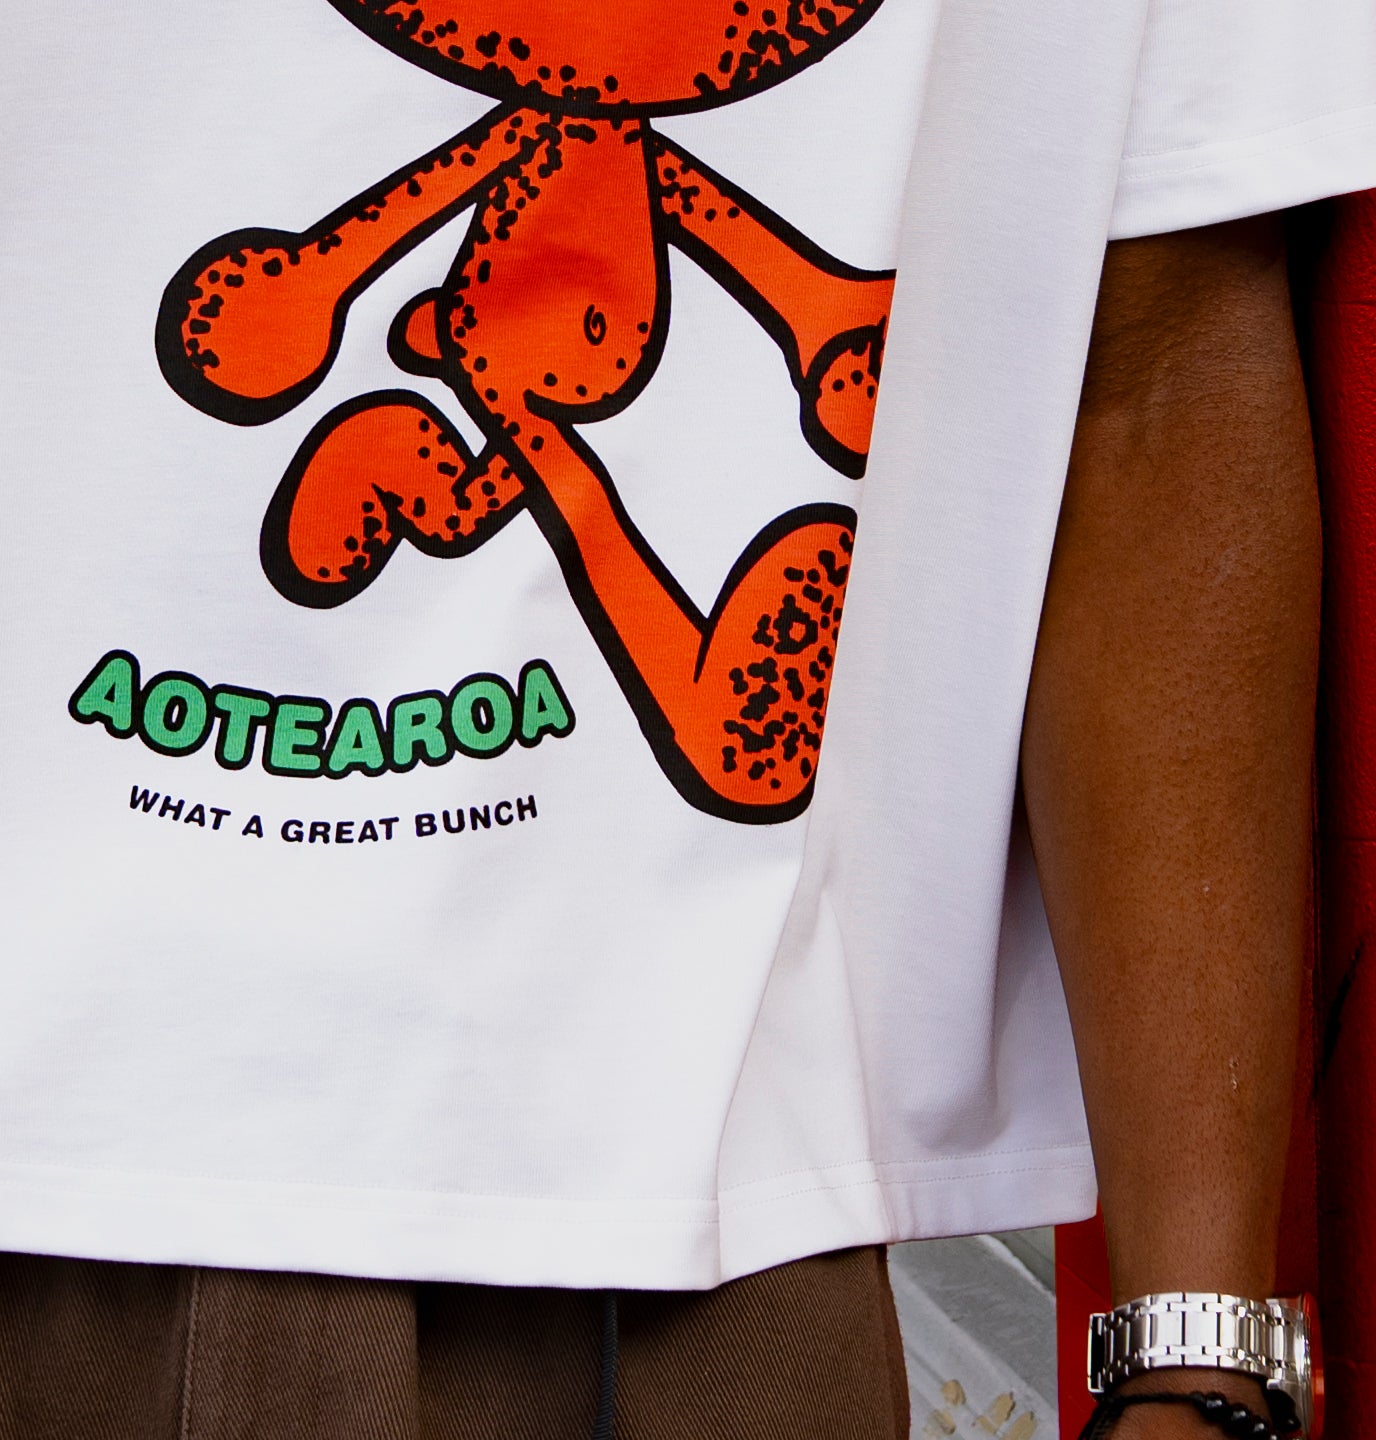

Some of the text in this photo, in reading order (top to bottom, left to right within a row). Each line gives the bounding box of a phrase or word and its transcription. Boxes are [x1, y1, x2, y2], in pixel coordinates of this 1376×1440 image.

[68, 649, 576, 780] AOTEAROA
[129, 784, 538, 843] WHAT A GREAT BUNCH
